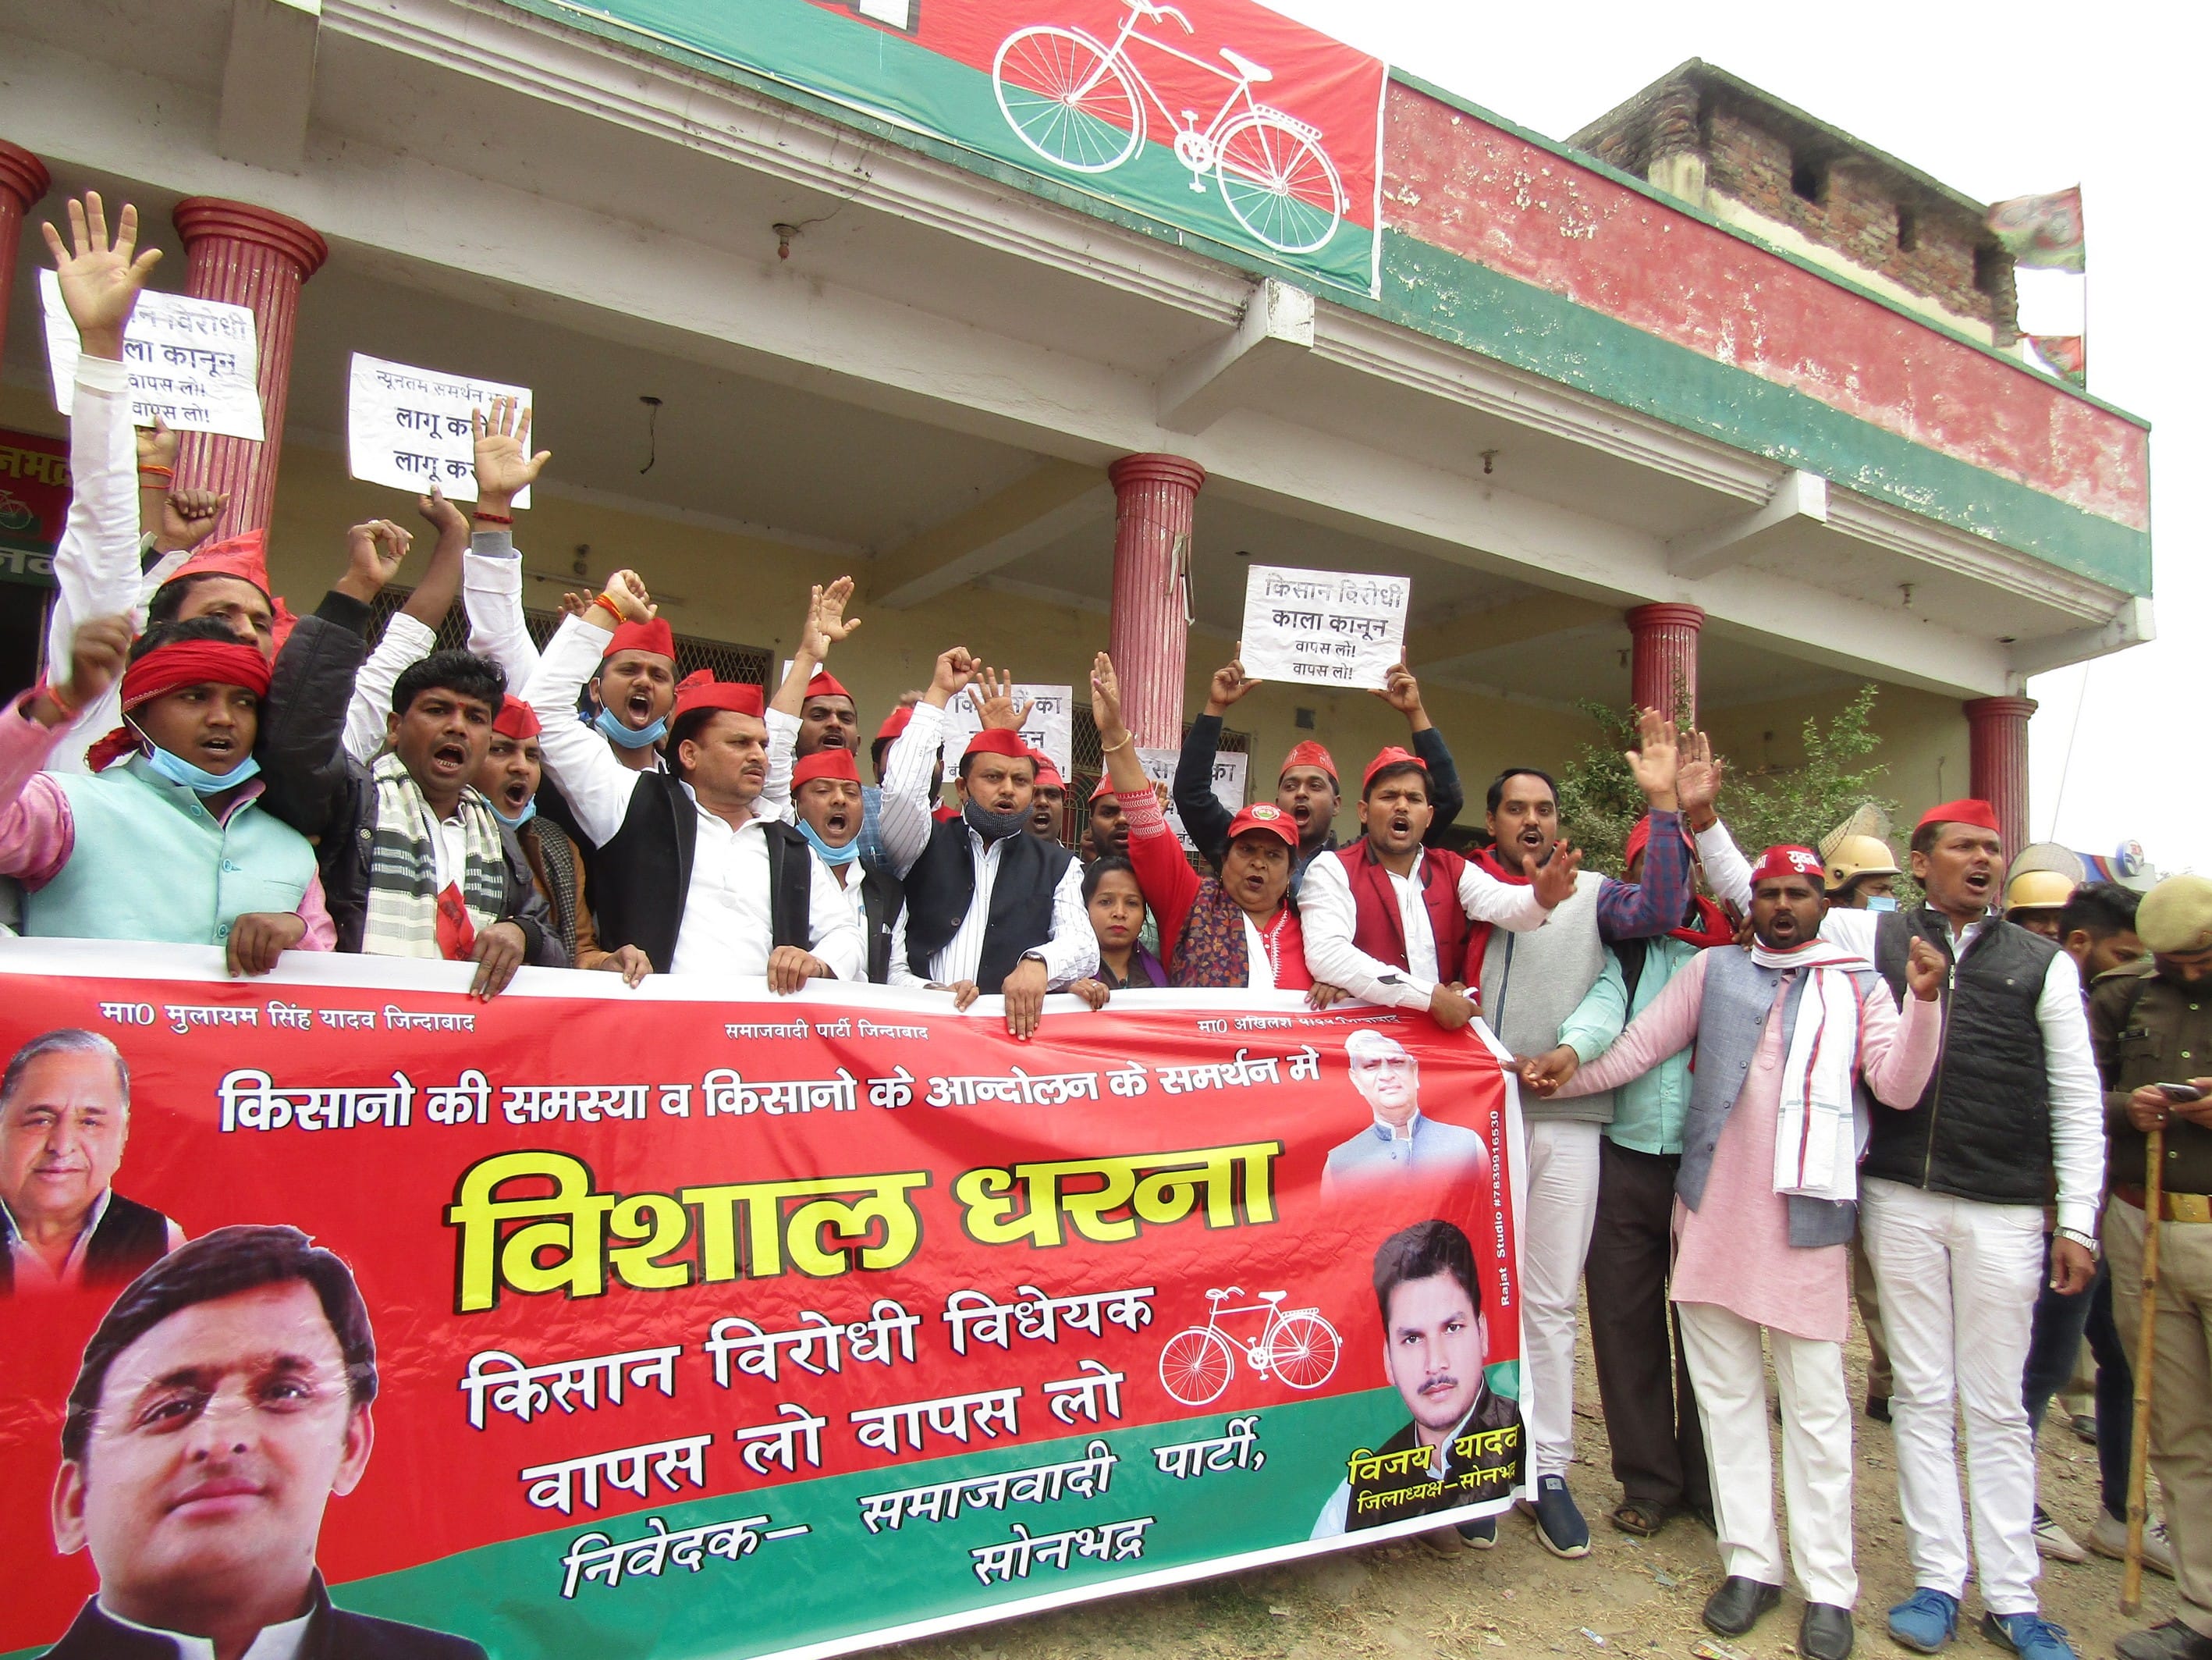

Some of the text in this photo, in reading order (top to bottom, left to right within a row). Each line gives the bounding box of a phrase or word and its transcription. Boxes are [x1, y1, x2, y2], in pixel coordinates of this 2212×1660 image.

[160, 343, 236, 376] कानून
[128, 373, 206, 398] वापस लो!
[376, 370, 428, 393] न्यूनतम
[433, 381, 483, 403] समर्थन
[133, 401, 211, 424] वापस लो!
[396, 406, 443, 440] लागू
[393, 450, 442, 482] लागू
[1264, 572, 1403, 609] किसान विरोधी
[1272, 608, 1389, 642] काला कानून
[1294, 640, 1356, 658] वापस लो!
[1292, 662, 1354, 680] वापस लो!
[1035, 696, 1062, 714] का
[165, 1001, 259, 1034] मुलायम
[268, 1001, 312, 1029] सिंह
[319, 1008, 376, 1030] यादव
[383, 1004, 475, 1033] जिन्दाबाद
[725, 1017, 930, 1041] समाजवादी पार्टी जिन्दाबाद
[218, 1045, 1321, 1132] किसानो की समस्या व किसानो के आन्दोलन के समर्थन मे
[1489, 1110, 1510, 1306] Rajat Studio #7839916530
[446, 1139, 1284, 1314] विशाल धरना
[460, 1285, 1156, 1431] किसान विरोधी विधेयक
[519, 1359, 1125, 1516] वापस लो वापस लो
[1346, 1423, 1521, 1486] विजय यादव
[857, 1439, 1120, 1535] समाजवादी
[1152, 1415, 1268, 1480] पार्टी,
[969, 1516, 1156, 1587] सोनभद्र
